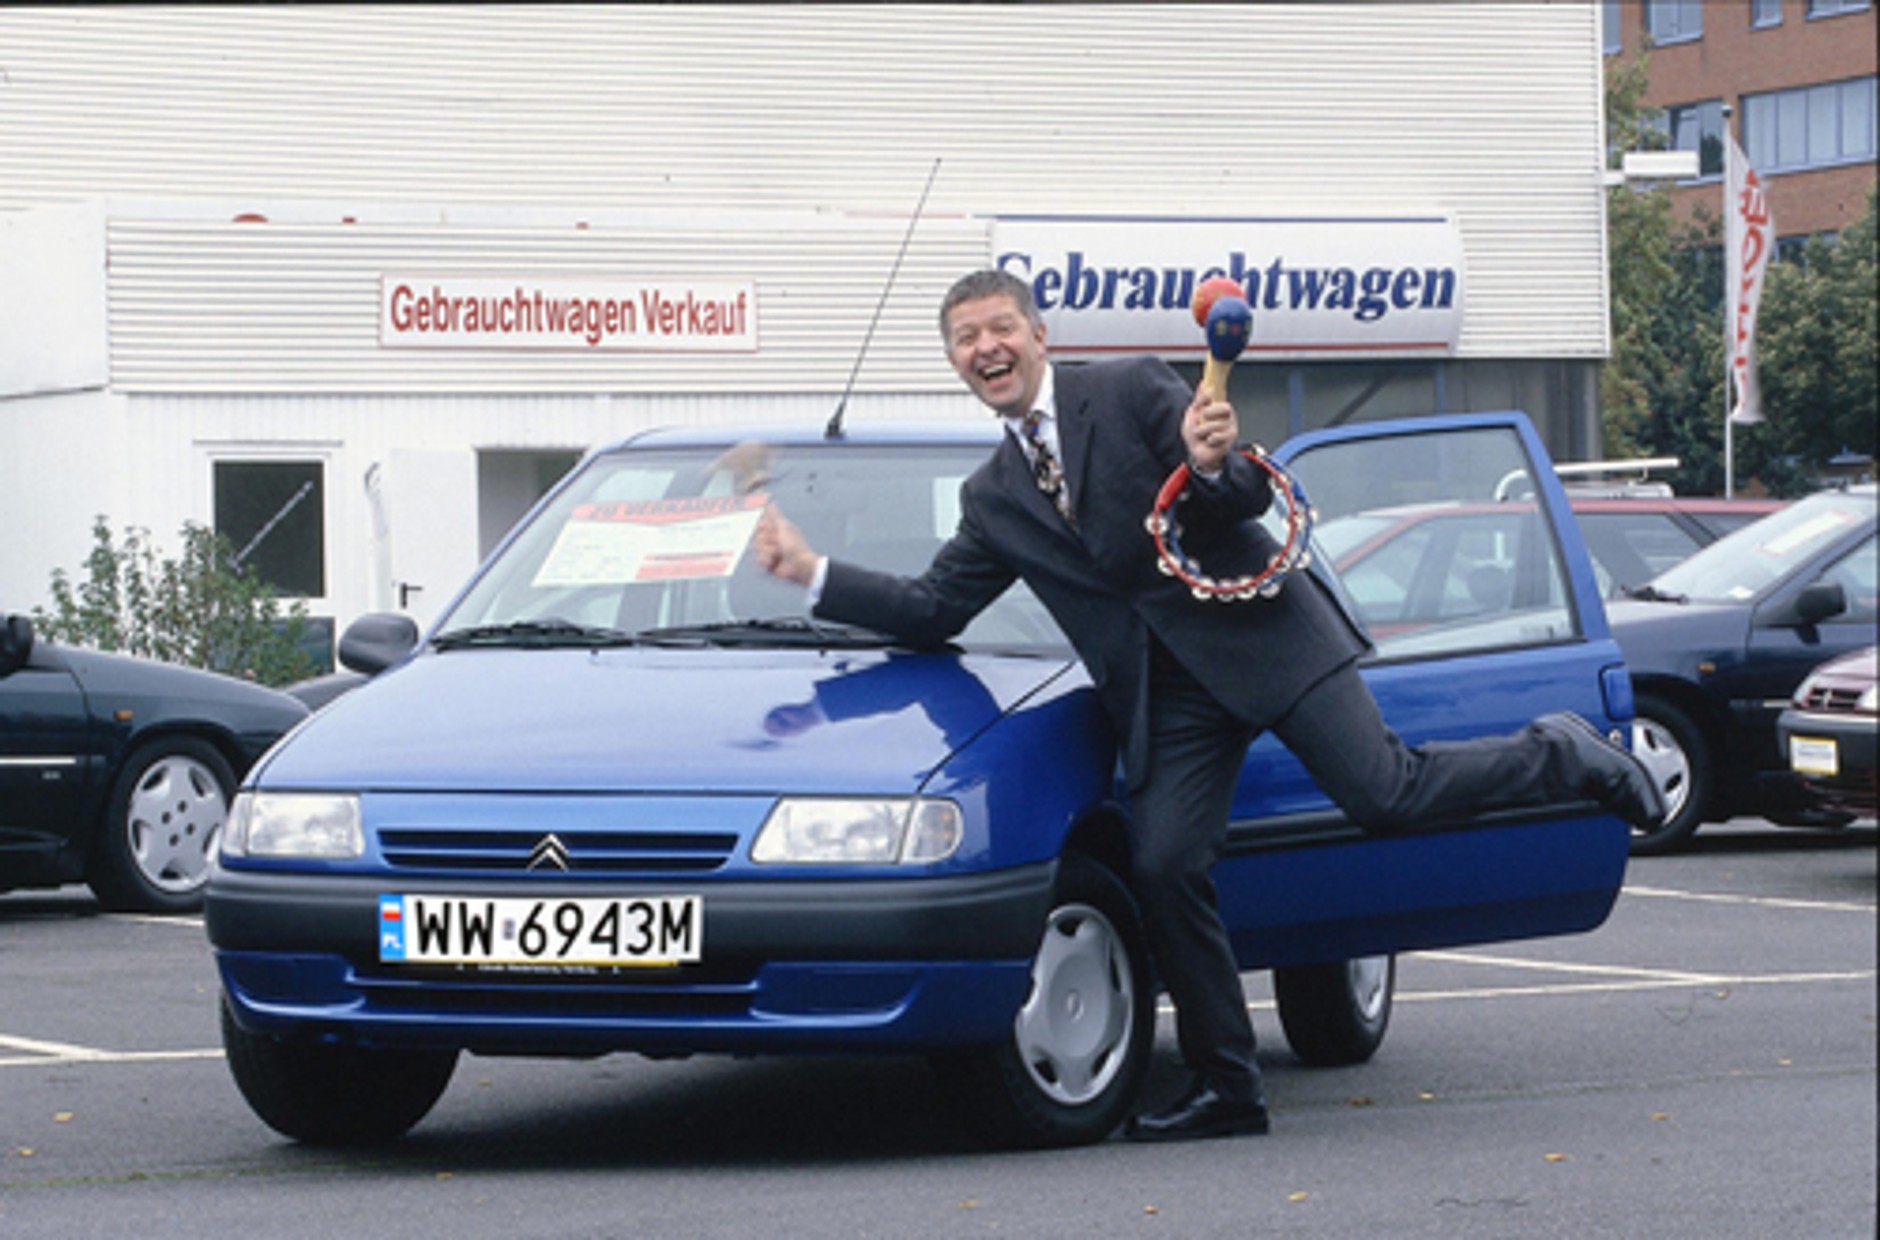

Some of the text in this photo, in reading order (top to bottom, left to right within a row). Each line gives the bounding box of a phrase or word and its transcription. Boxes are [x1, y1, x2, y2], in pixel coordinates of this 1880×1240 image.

[390, 284, 746, 345] Gebrauchtwagen Verkauf
[997, 251, 1456, 321] ebrauhtwagen
[415, 898, 694, 957] WW 6943M
